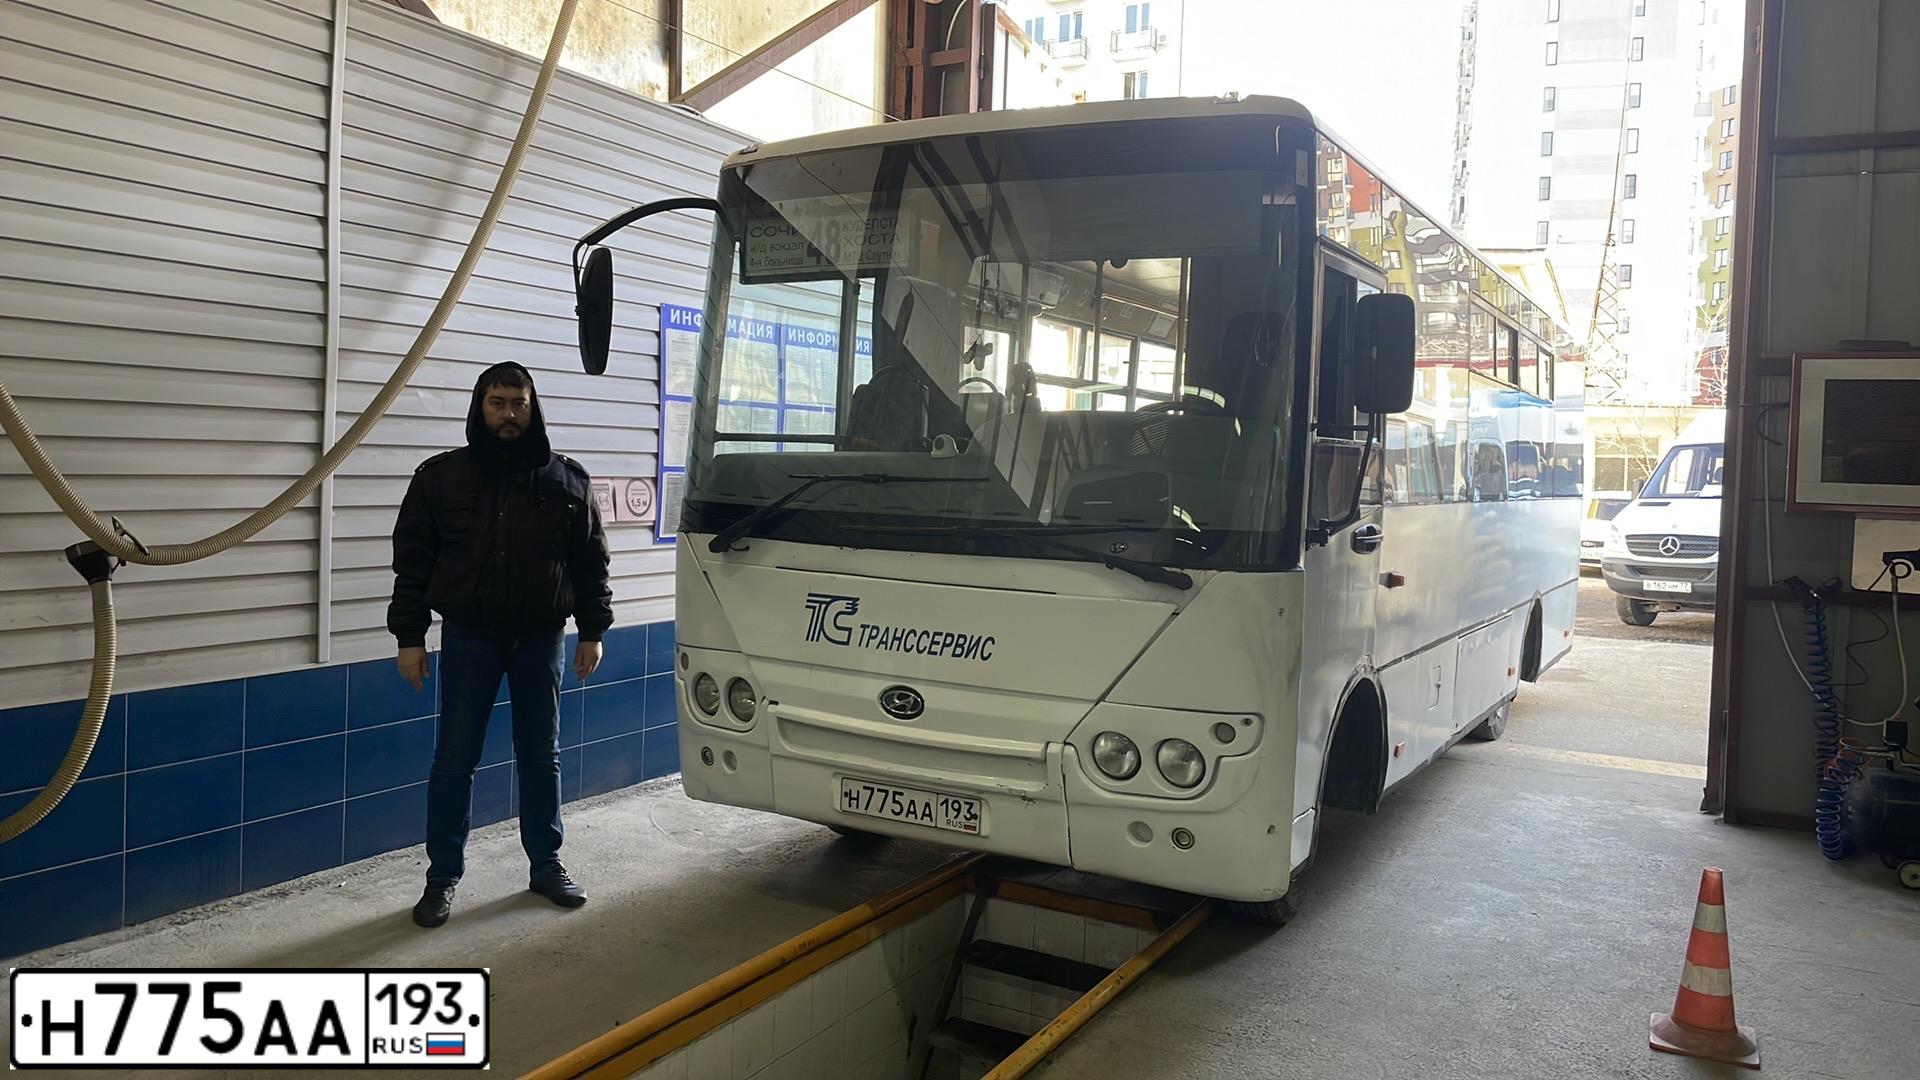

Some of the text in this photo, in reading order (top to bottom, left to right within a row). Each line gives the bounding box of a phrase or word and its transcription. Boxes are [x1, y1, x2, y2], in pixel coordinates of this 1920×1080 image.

[842, 232, 901, 247] ХОСТА
[670, 308, 773, 339] ИНФМАЦИЯ
[858, 624, 996, 662] ТРАНССЕРВИС
[848, 785, 974, 823] Н775АА 193
[945, 819, 963, 829] RUS
